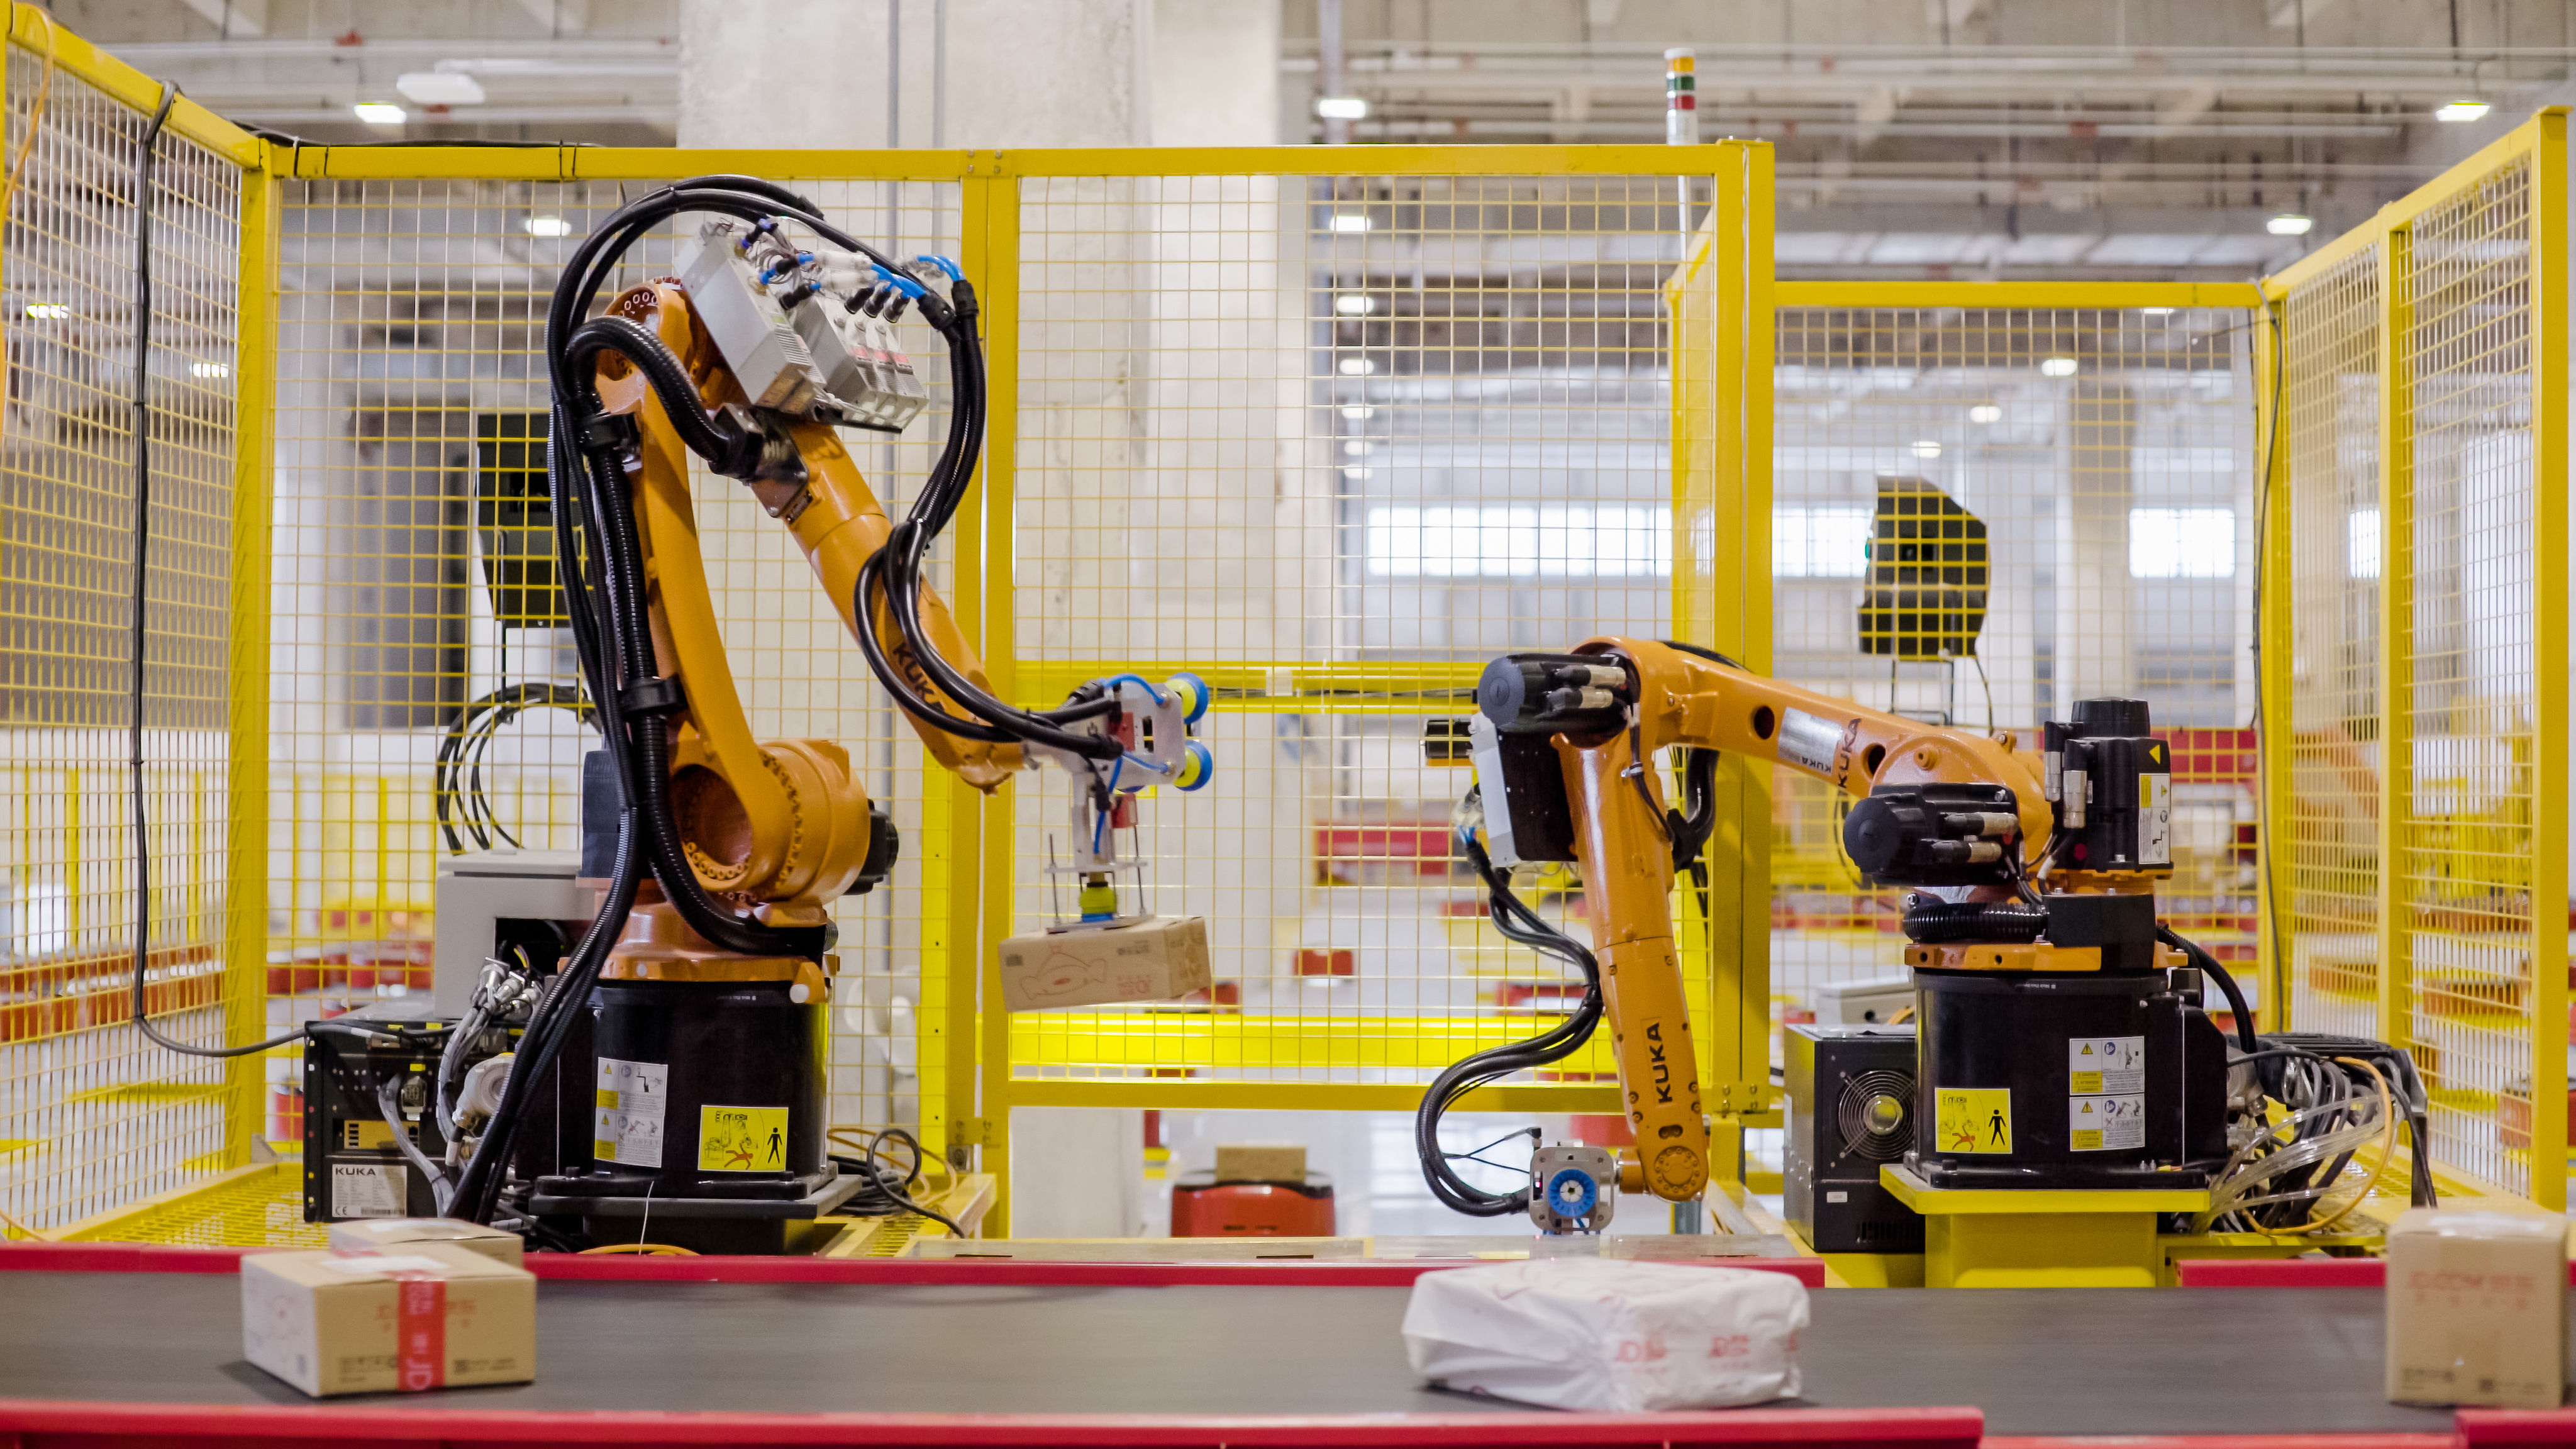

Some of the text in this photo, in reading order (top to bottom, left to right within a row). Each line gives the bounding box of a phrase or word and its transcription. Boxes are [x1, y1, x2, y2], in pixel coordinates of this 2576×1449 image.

[892, 642, 945, 712] KUK
[1801, 756, 1831, 774] KUKA
[1838, 718, 1862, 789] KUKA
[1646, 1021, 1673, 1104] KUKA
[335, 1167, 376, 1176] KUKA
[406, 1358, 433, 1391] JD
